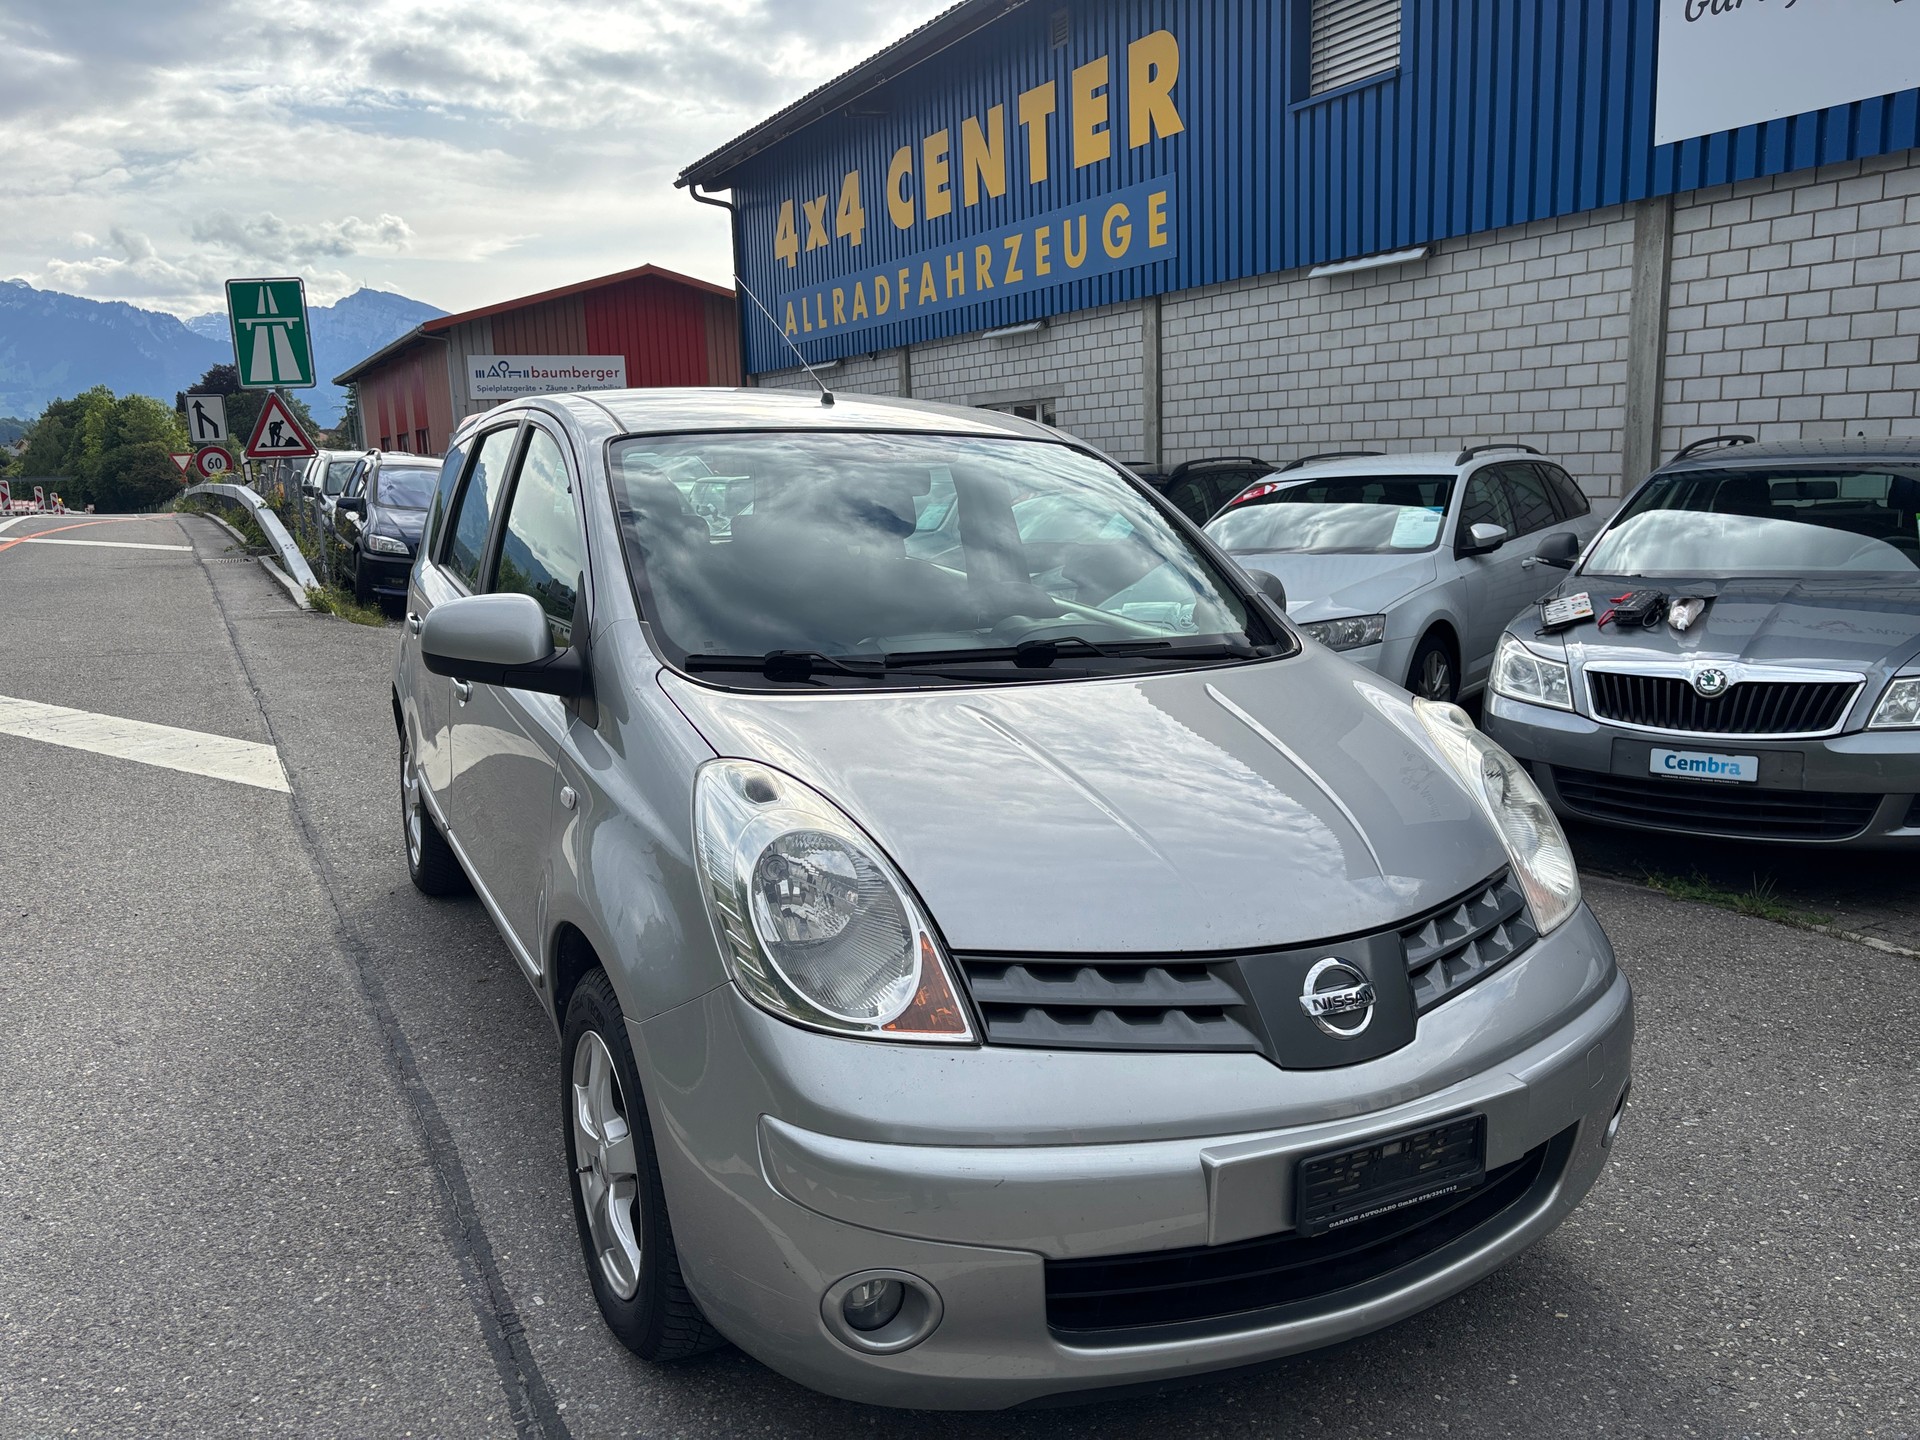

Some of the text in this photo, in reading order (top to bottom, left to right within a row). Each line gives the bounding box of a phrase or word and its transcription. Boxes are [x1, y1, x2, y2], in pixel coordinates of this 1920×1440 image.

[774, 29, 1185, 268] 4x4 CENTER
[784, 190, 1168, 337] ALLRADFAHRZEUGE
[531, 365, 619, 381] baumberger
[476, 384, 536, 393] Spielplatzgeräte
[207, 457, 222, 470] 60
[1664, 754, 1742, 776] Cembra
[1311, 987, 1374, 1011] NISSAN
[1328, 1215, 1359, 1228] GARAGE
[1397, 1197, 1418, 1208] GmbH
